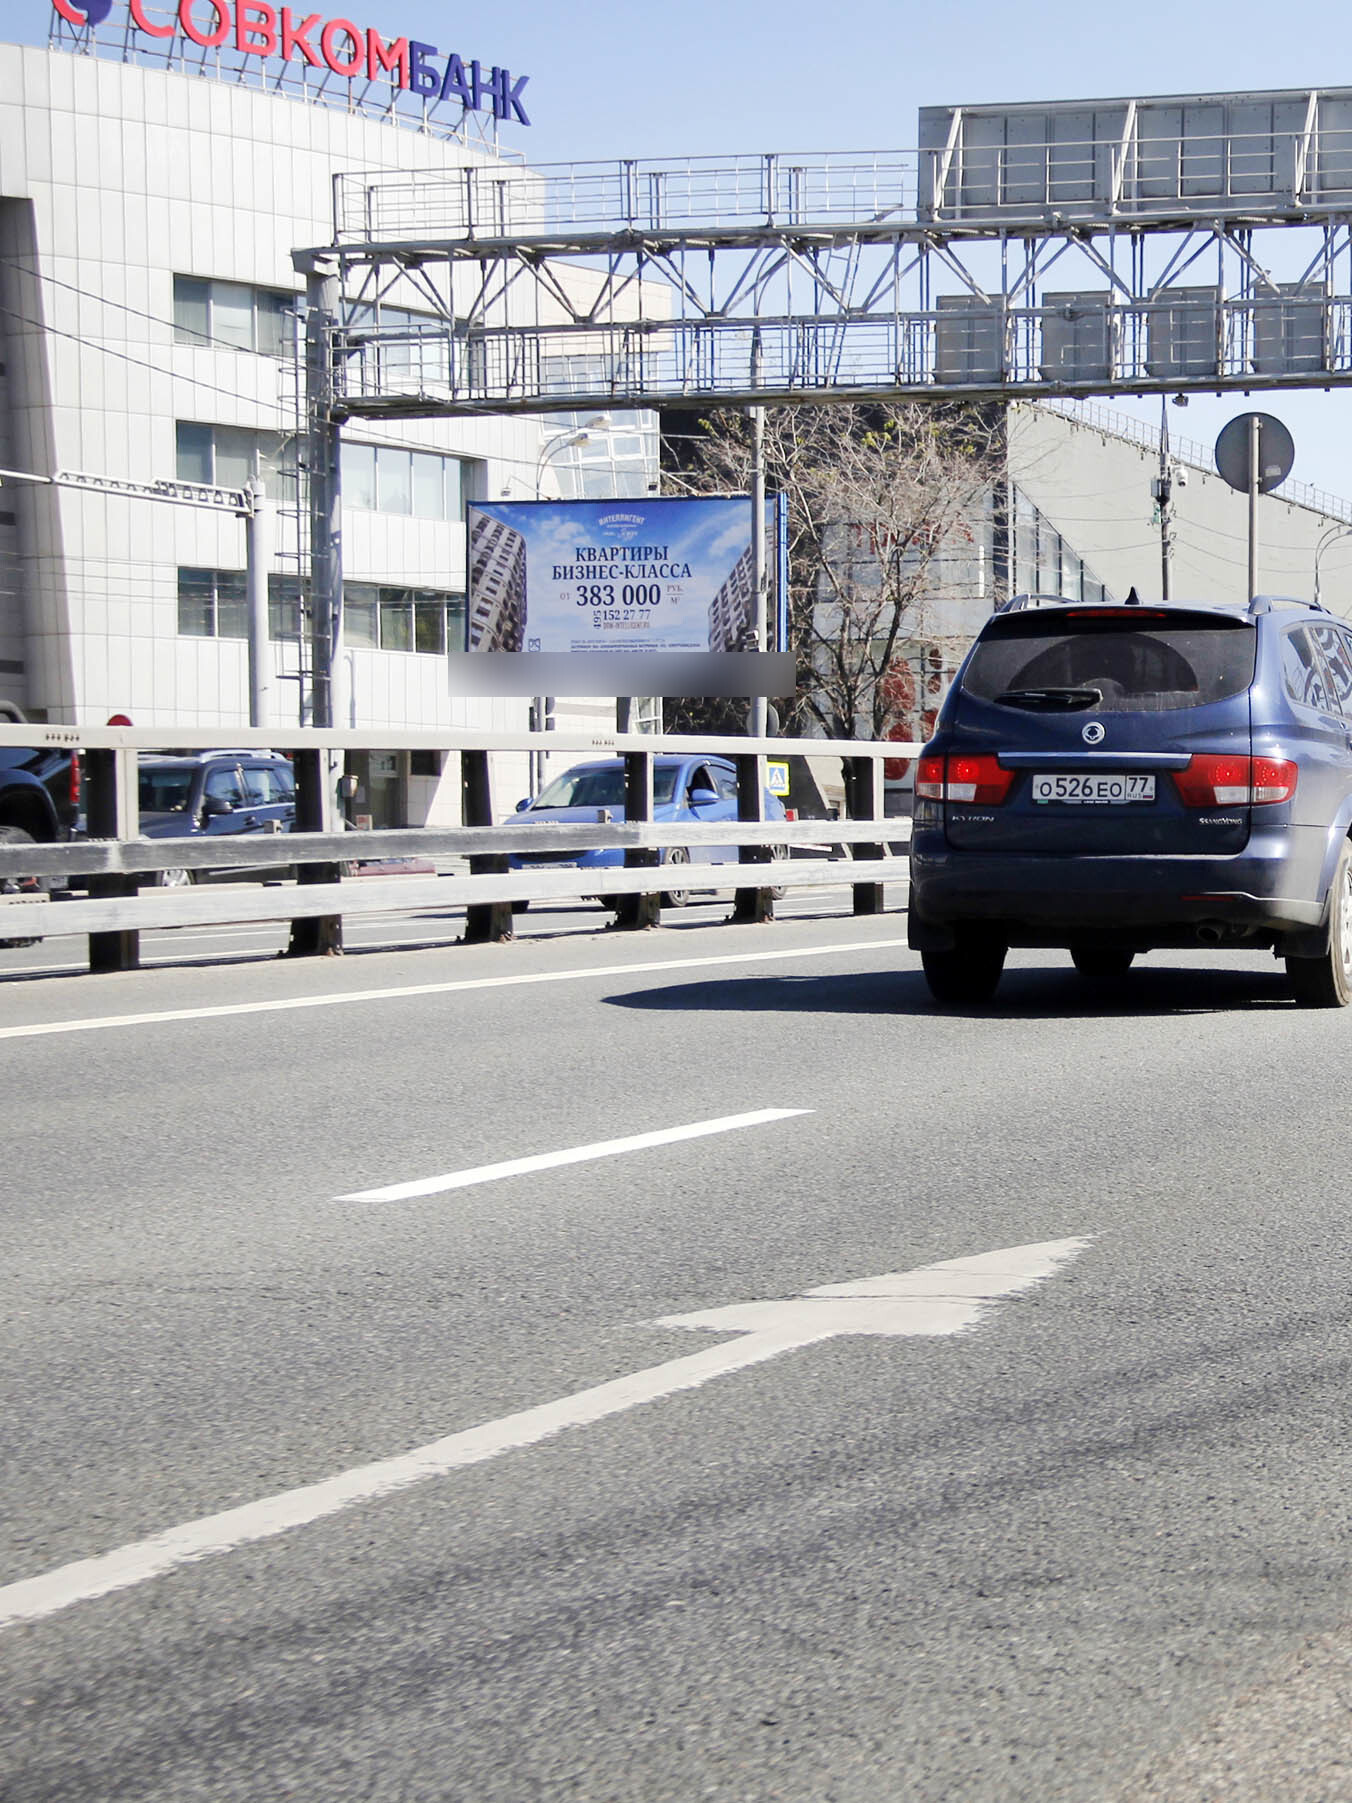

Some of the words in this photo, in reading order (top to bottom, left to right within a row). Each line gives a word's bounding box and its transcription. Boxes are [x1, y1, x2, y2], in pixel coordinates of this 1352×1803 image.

[130, 0, 532, 127] СОВКОМБАНК
[575, 546, 669, 562] КВАРТИРЫ
[552, 563, 692, 580] БИЗНЕС-КЛАССА
[576, 584, 615, 606] 383
[622, 584, 661, 606] 000
[603, 609, 621, 621] 152
[623, 609, 635, 620] 27
[639, 609, 651, 620] 77
[1128, 776, 1149, 792] 77
